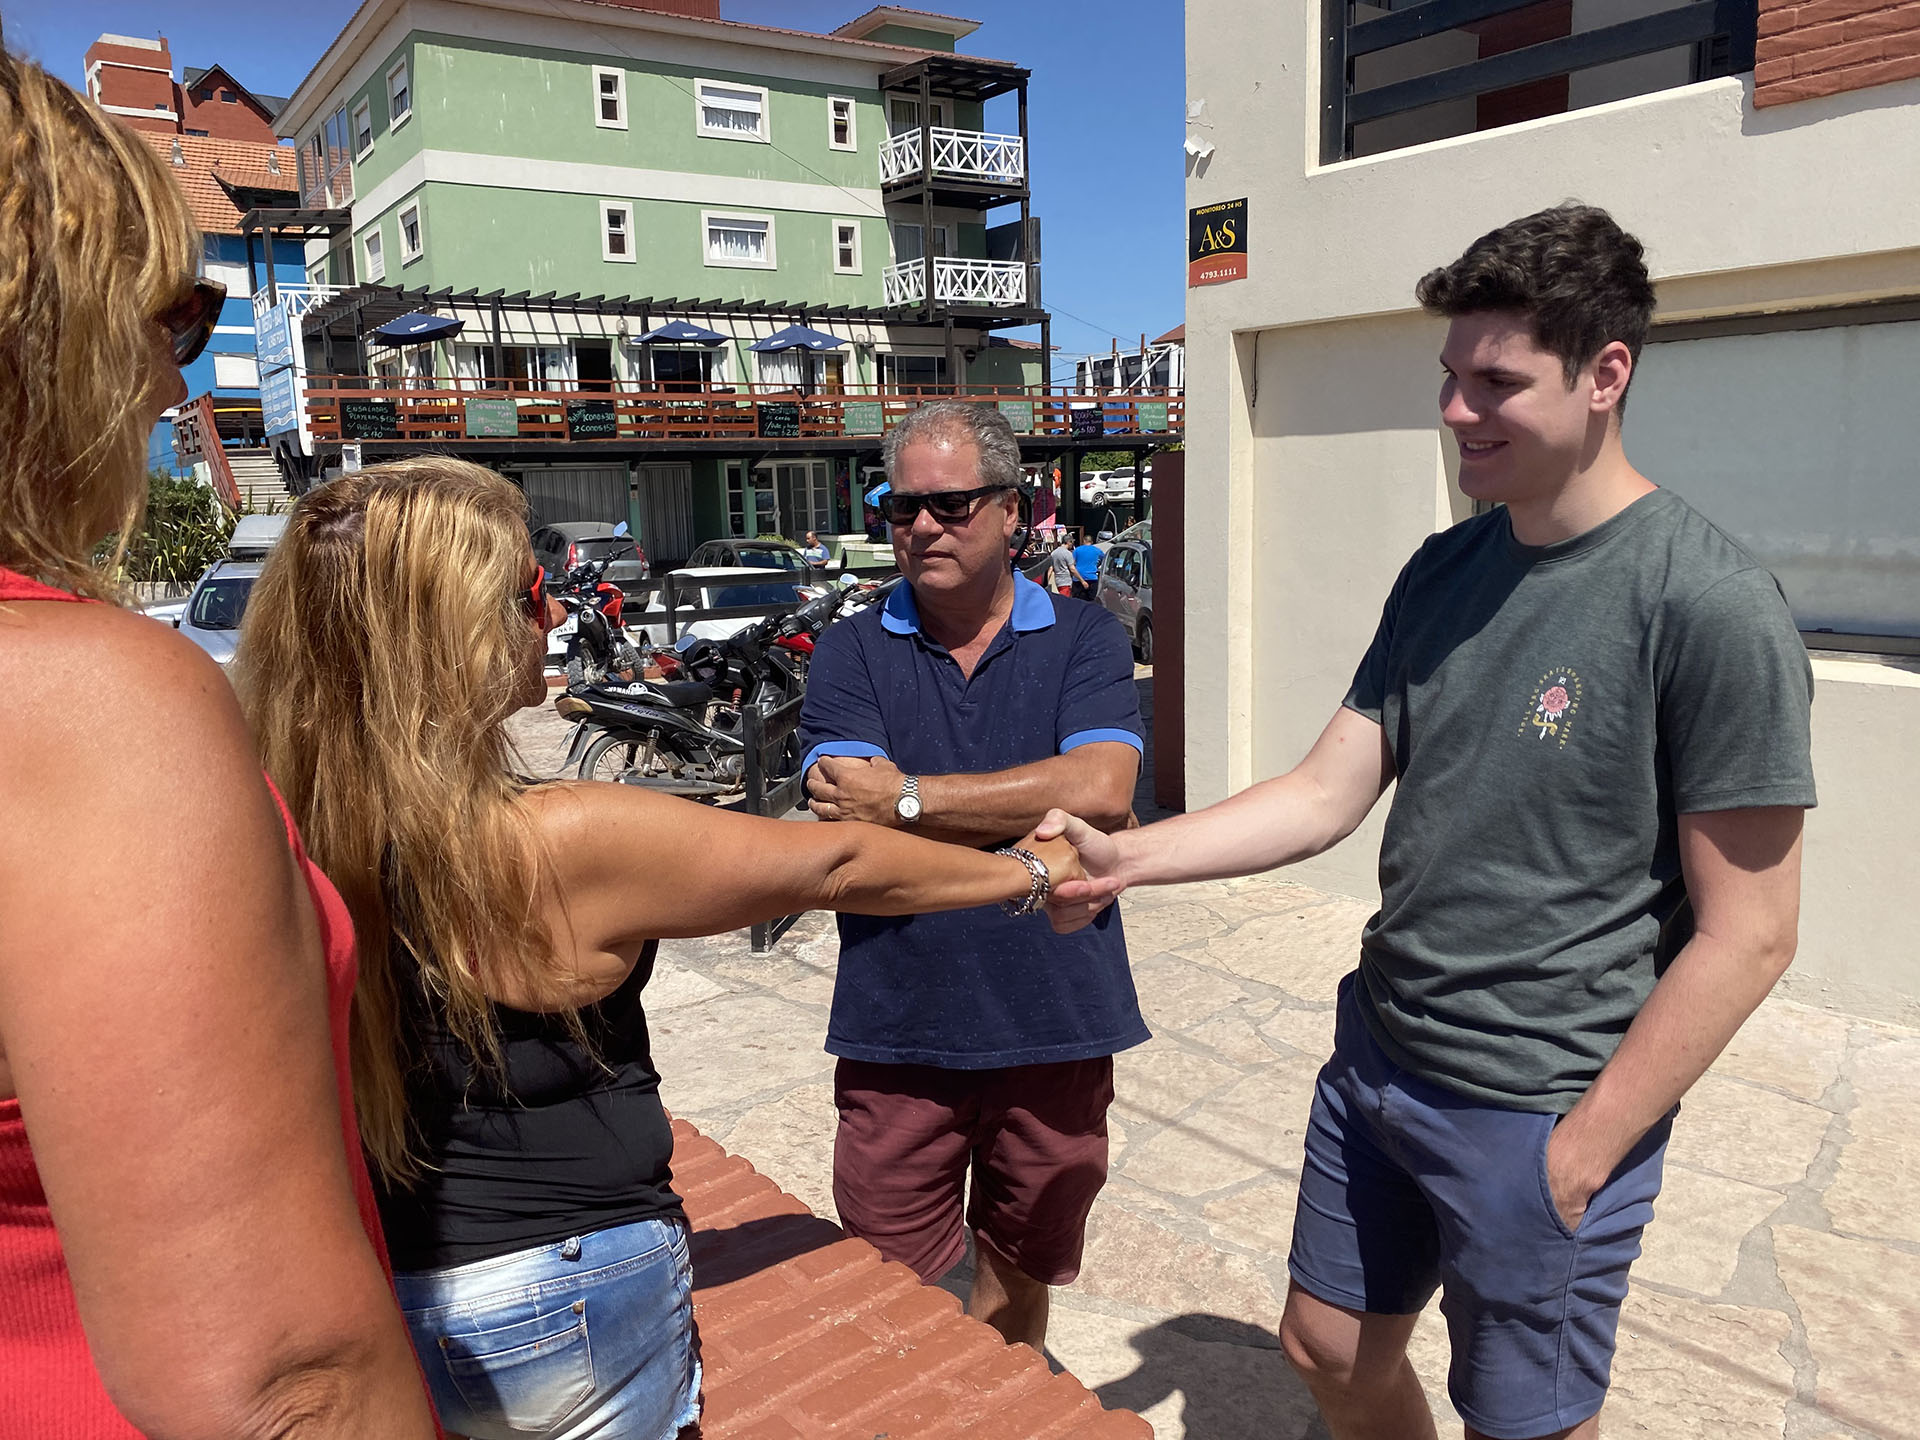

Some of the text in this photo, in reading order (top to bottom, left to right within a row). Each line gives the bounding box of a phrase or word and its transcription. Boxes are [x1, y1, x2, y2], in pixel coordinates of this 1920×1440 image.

[1196, 204, 1226, 216] MONITOREO
[1226, 202, 1235, 210] 24
[1198, 218, 1237, 253] A&S
[1200, 266, 1237, 280] 4793.1111
[346, 405, 389, 414] ENSALADAS
